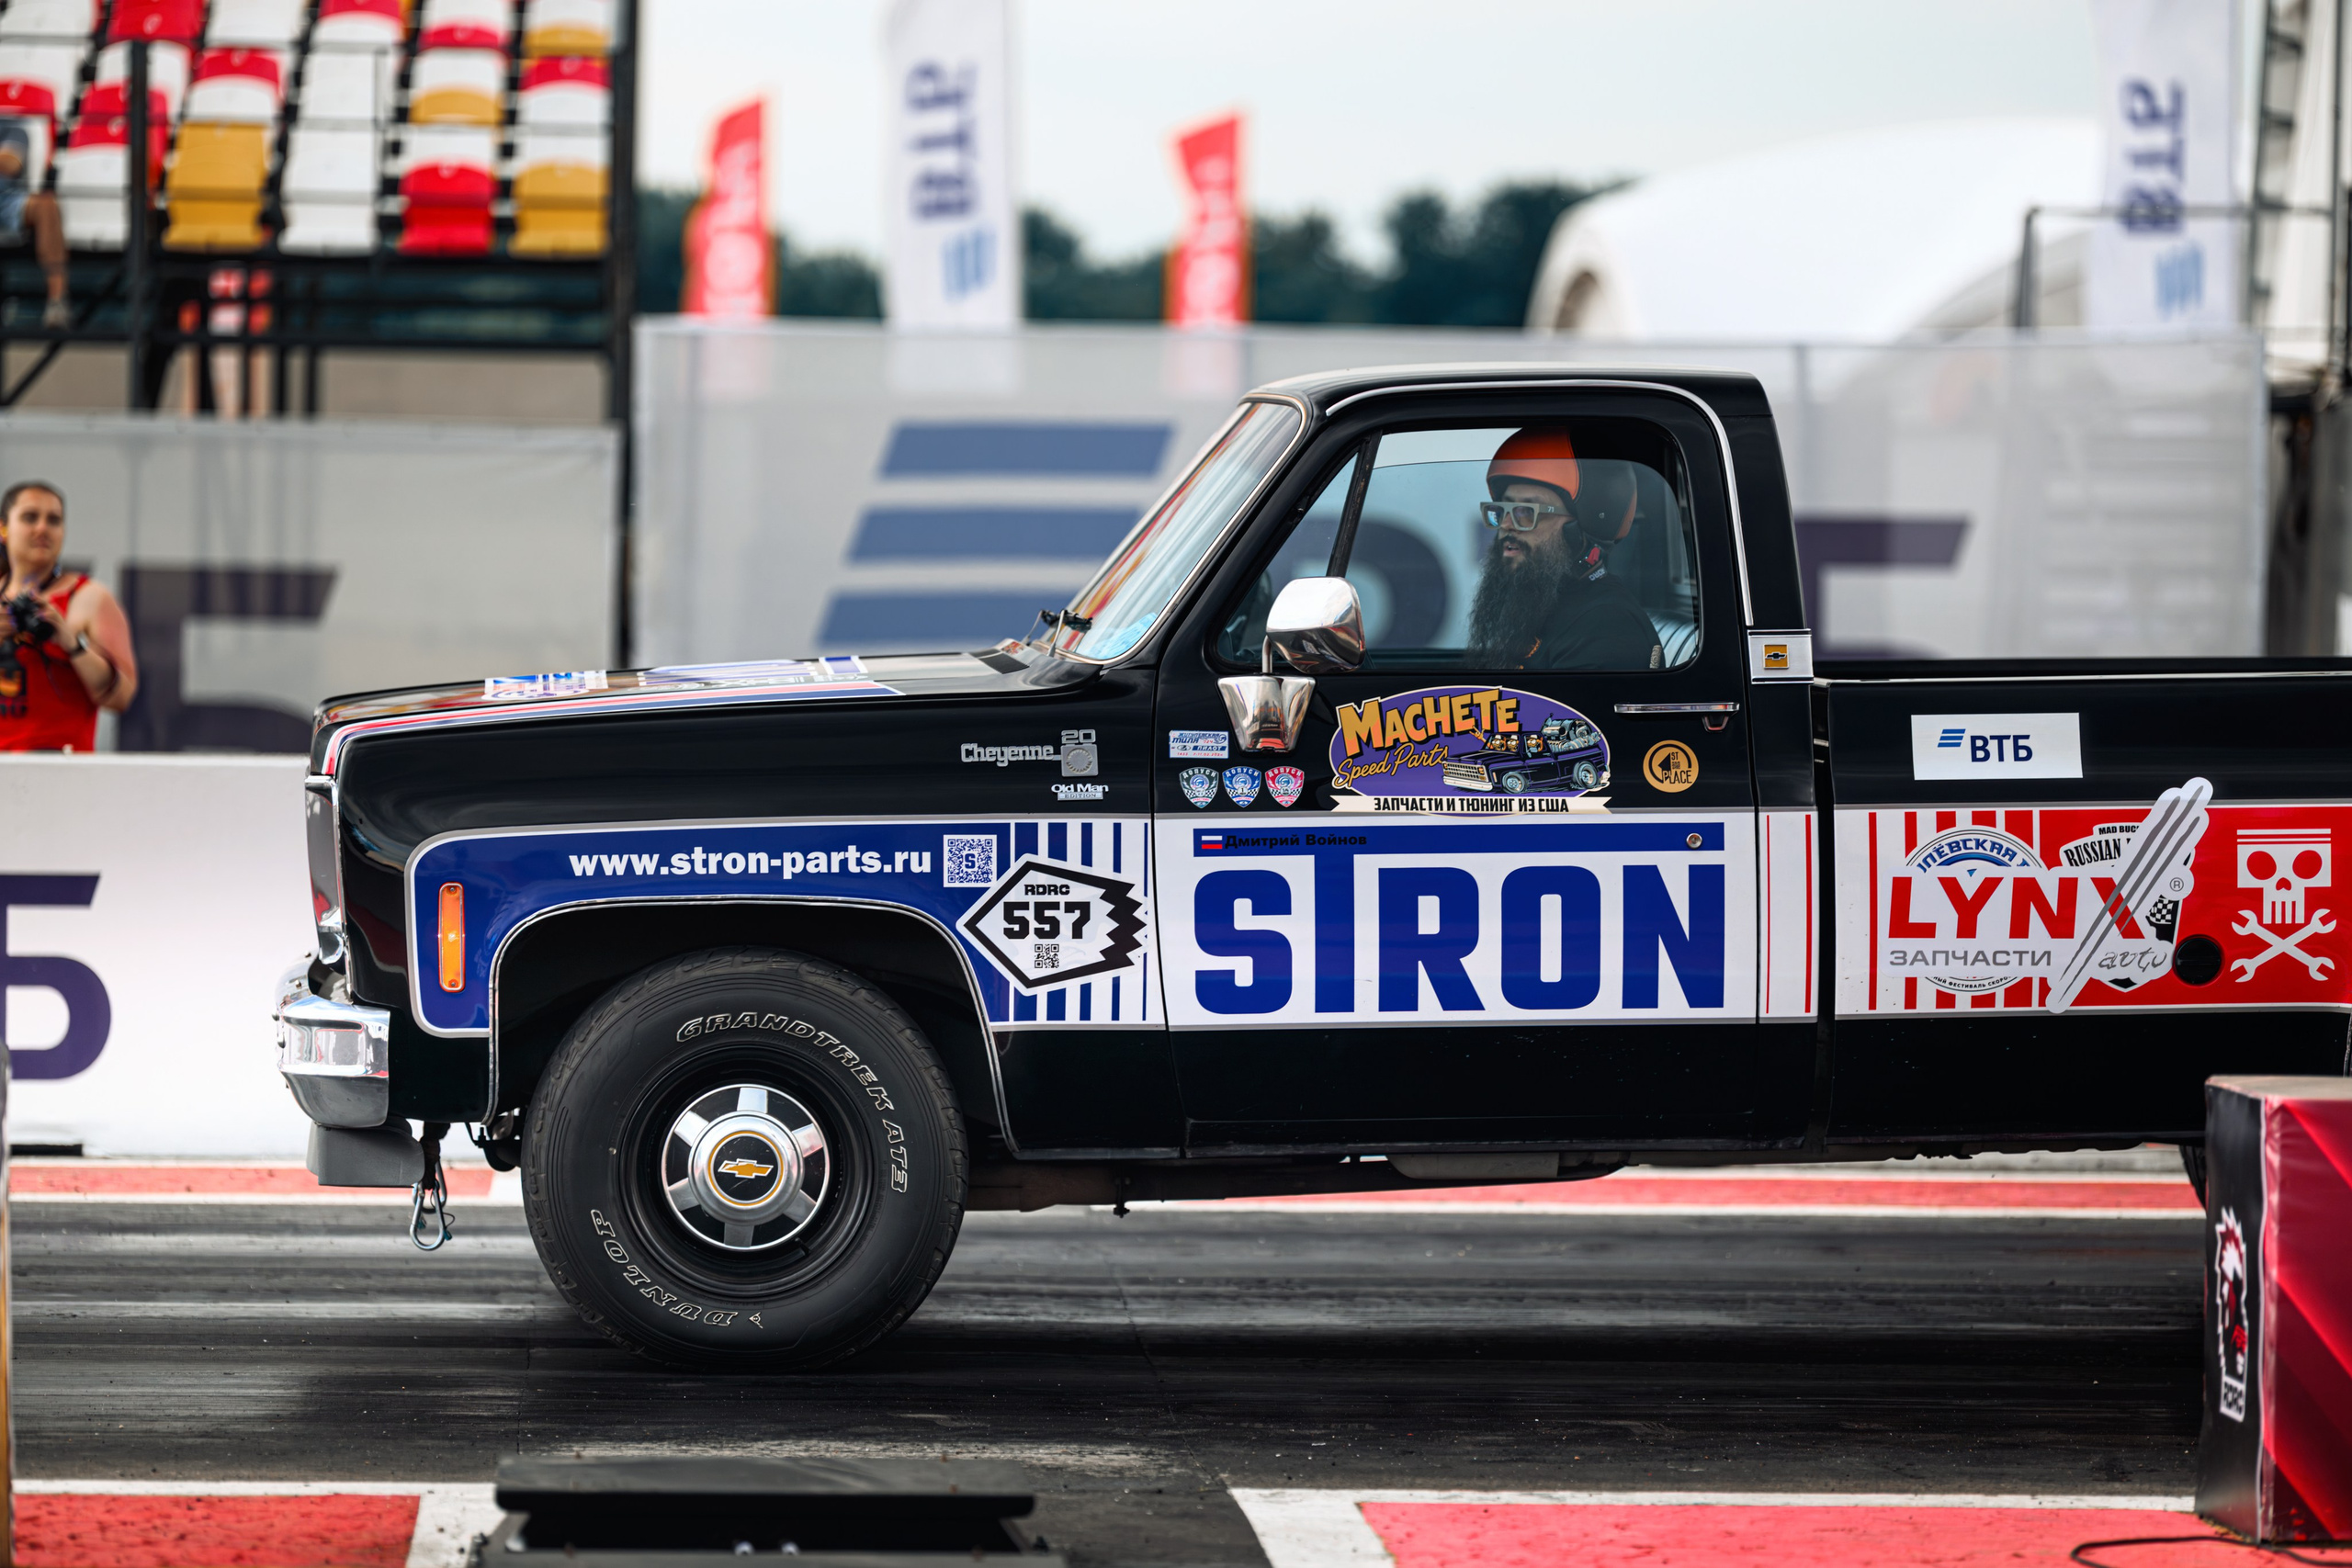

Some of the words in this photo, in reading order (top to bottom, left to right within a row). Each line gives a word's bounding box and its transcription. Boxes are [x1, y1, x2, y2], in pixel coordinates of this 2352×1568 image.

[1338, 687, 1521, 758] MACHETE
[1061, 728, 1096, 744] 20
[1970, 734, 2033, 762] ВТБ
[960, 742, 1054, 767] Cheyenne
[1333, 757, 1391, 788] Speed
[1390, 741, 1449, 776] Parts
[1051, 784, 1074, 793] Old
[1077, 783, 1109, 793] Man
[1662, 770, 1692, 784] PLACE
[1374, 797, 1442, 812] ЗАПЧАСТИ
[1445, 797, 1455, 811] И
[1458, 797, 1515, 812] ТЮНИНГ
[1519, 798, 1535, 813] ИЗ
[1538, 798, 1569, 813] США
[1225, 834, 1300, 849] Дмитрий
[1306, 833, 1367, 846] Войнов
[2098, 826, 2117, 835] MAD
[569, 845, 932, 880] www.stron-parts.ru
[2064, 838, 2120, 867] RUSSIAN
[1023, 884, 1070, 896] RDRC
[1003, 901, 1091, 940] 557
[1193, 822, 1724, 1014] STRON
[1888, 876, 2145, 940] LYNX
[1889, 950, 2052, 967] ЗАПЧАСТИ
[1988, 976, 2010, 987] СКОРО
[676, 1011, 894, 1111] GRANDTREK
[882, 1119, 909, 1194] AT3
[591, 1209, 739, 1327] DUNLOP
